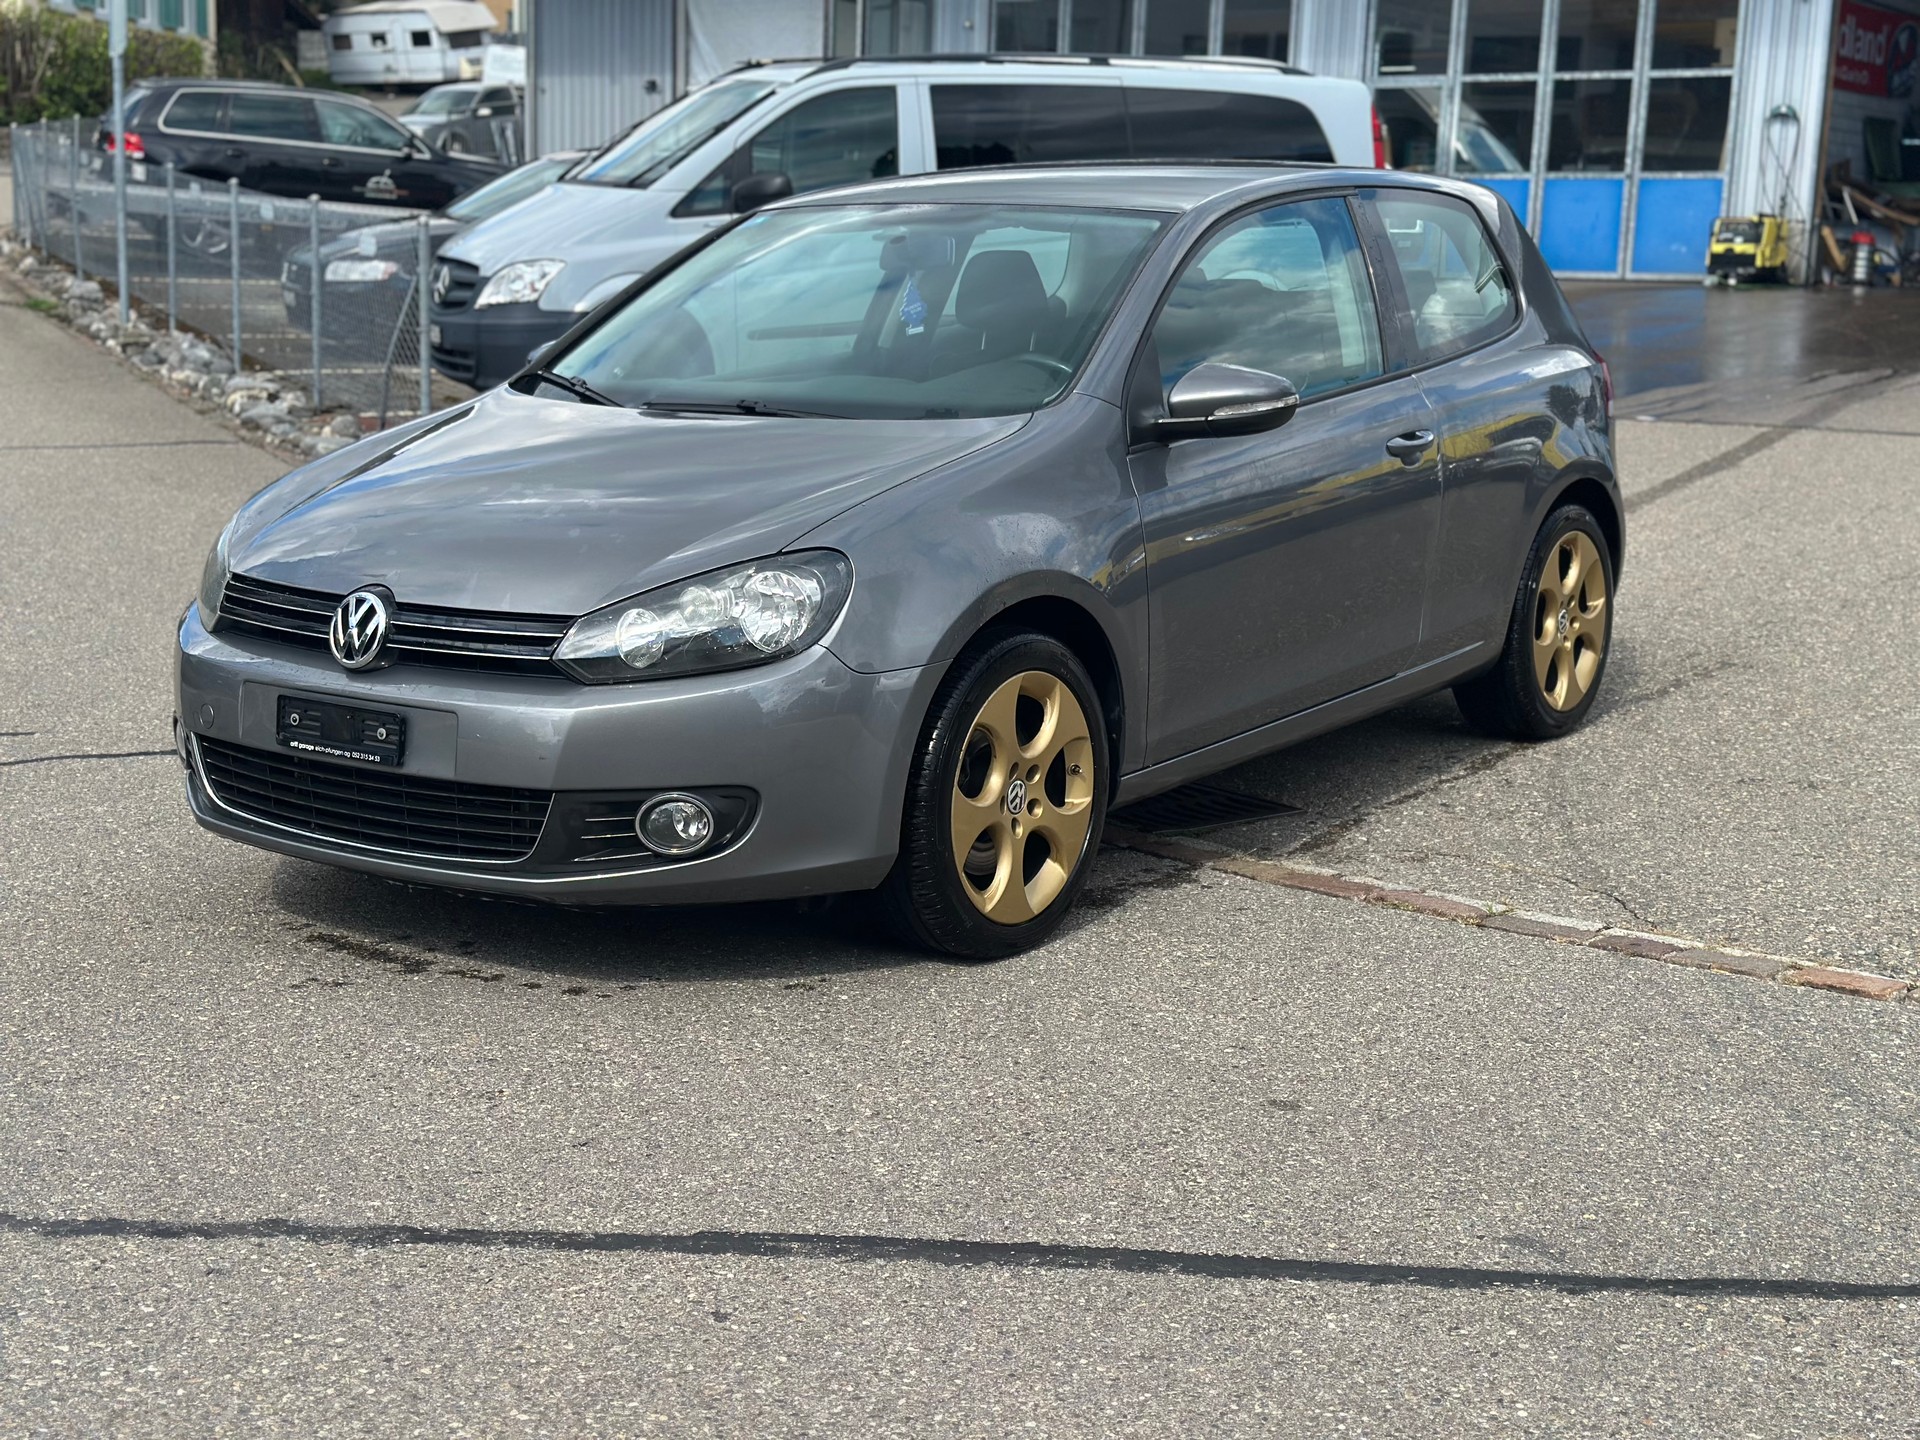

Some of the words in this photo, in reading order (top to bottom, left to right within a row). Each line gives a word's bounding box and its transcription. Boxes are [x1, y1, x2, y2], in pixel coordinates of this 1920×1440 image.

[298, 743, 315, 751] garage
[351, 751, 360, 759] 052
[360, 753, 369, 761] 315
